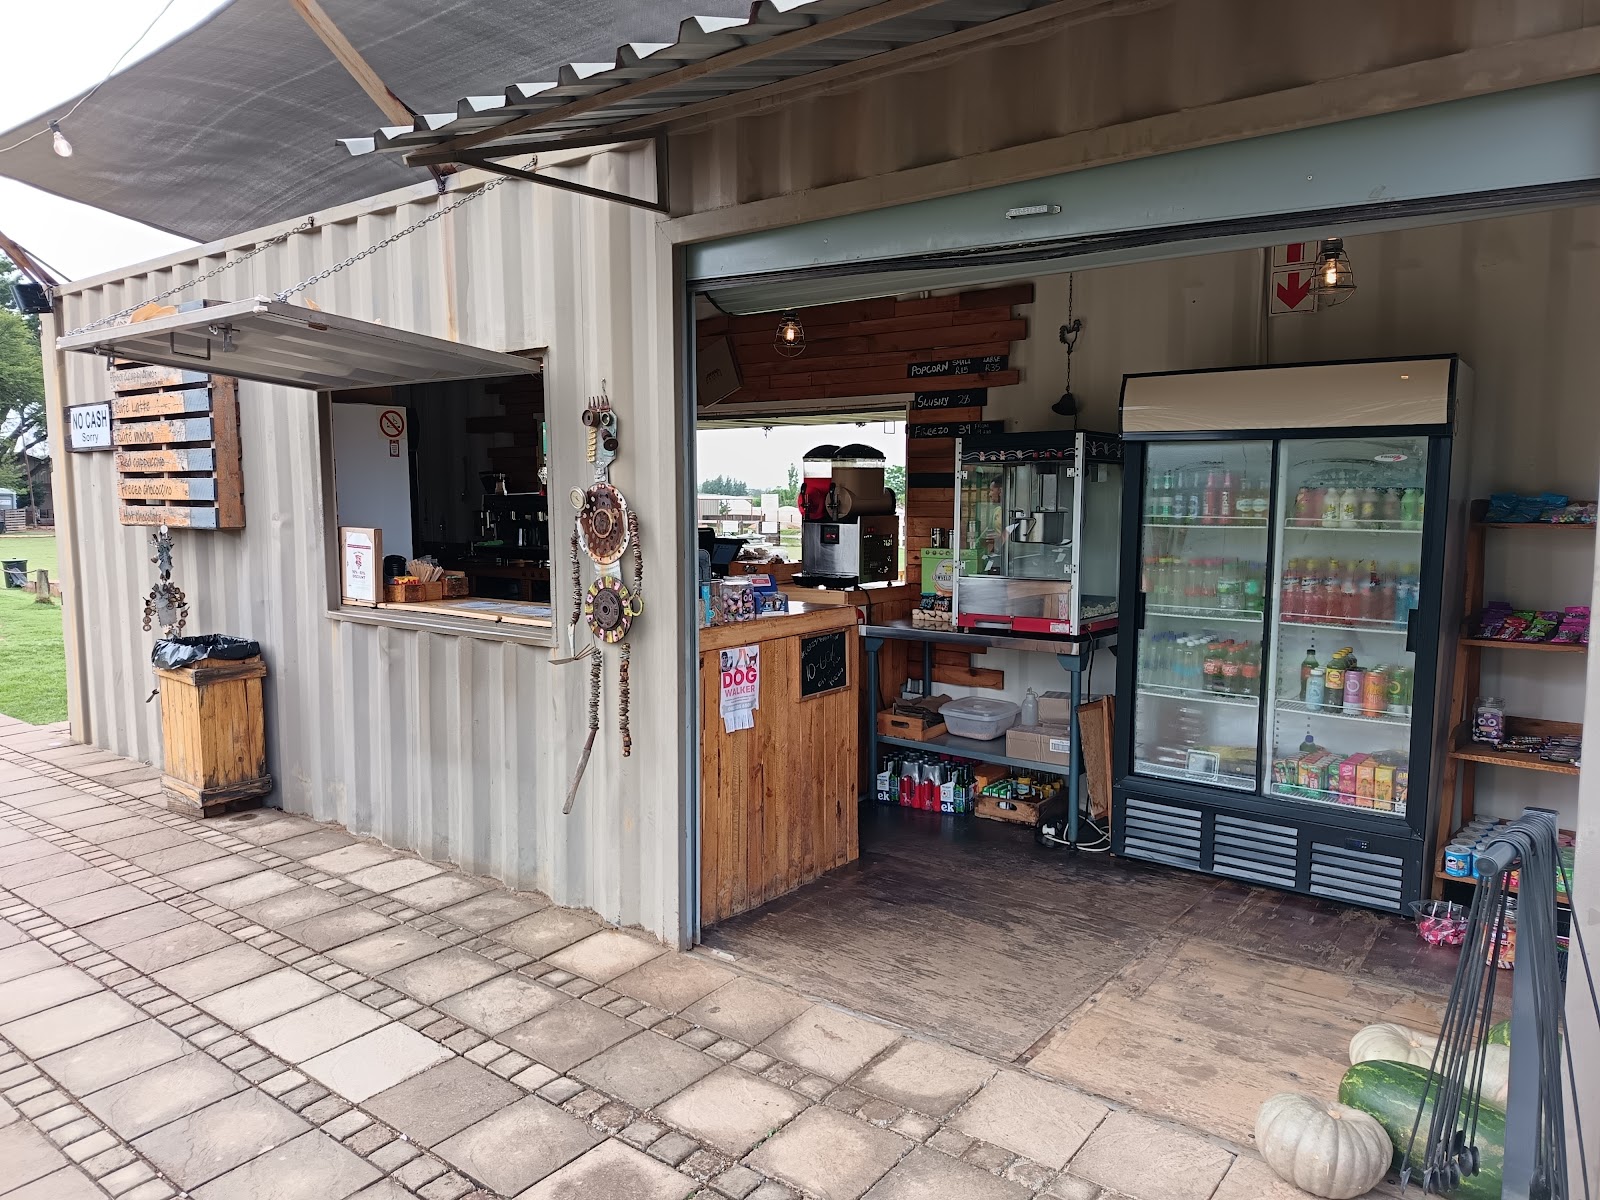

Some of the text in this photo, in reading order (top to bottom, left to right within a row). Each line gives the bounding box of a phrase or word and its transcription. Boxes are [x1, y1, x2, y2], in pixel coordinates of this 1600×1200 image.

[911, 361, 949, 377] POPCORN
[985, 363, 1001, 372] R35
[72, 410, 108, 430] NO CASH
[82, 432, 99, 444] Sorry
[722, 667, 757, 689] DOG
[724, 685, 756, 698] WALKER
